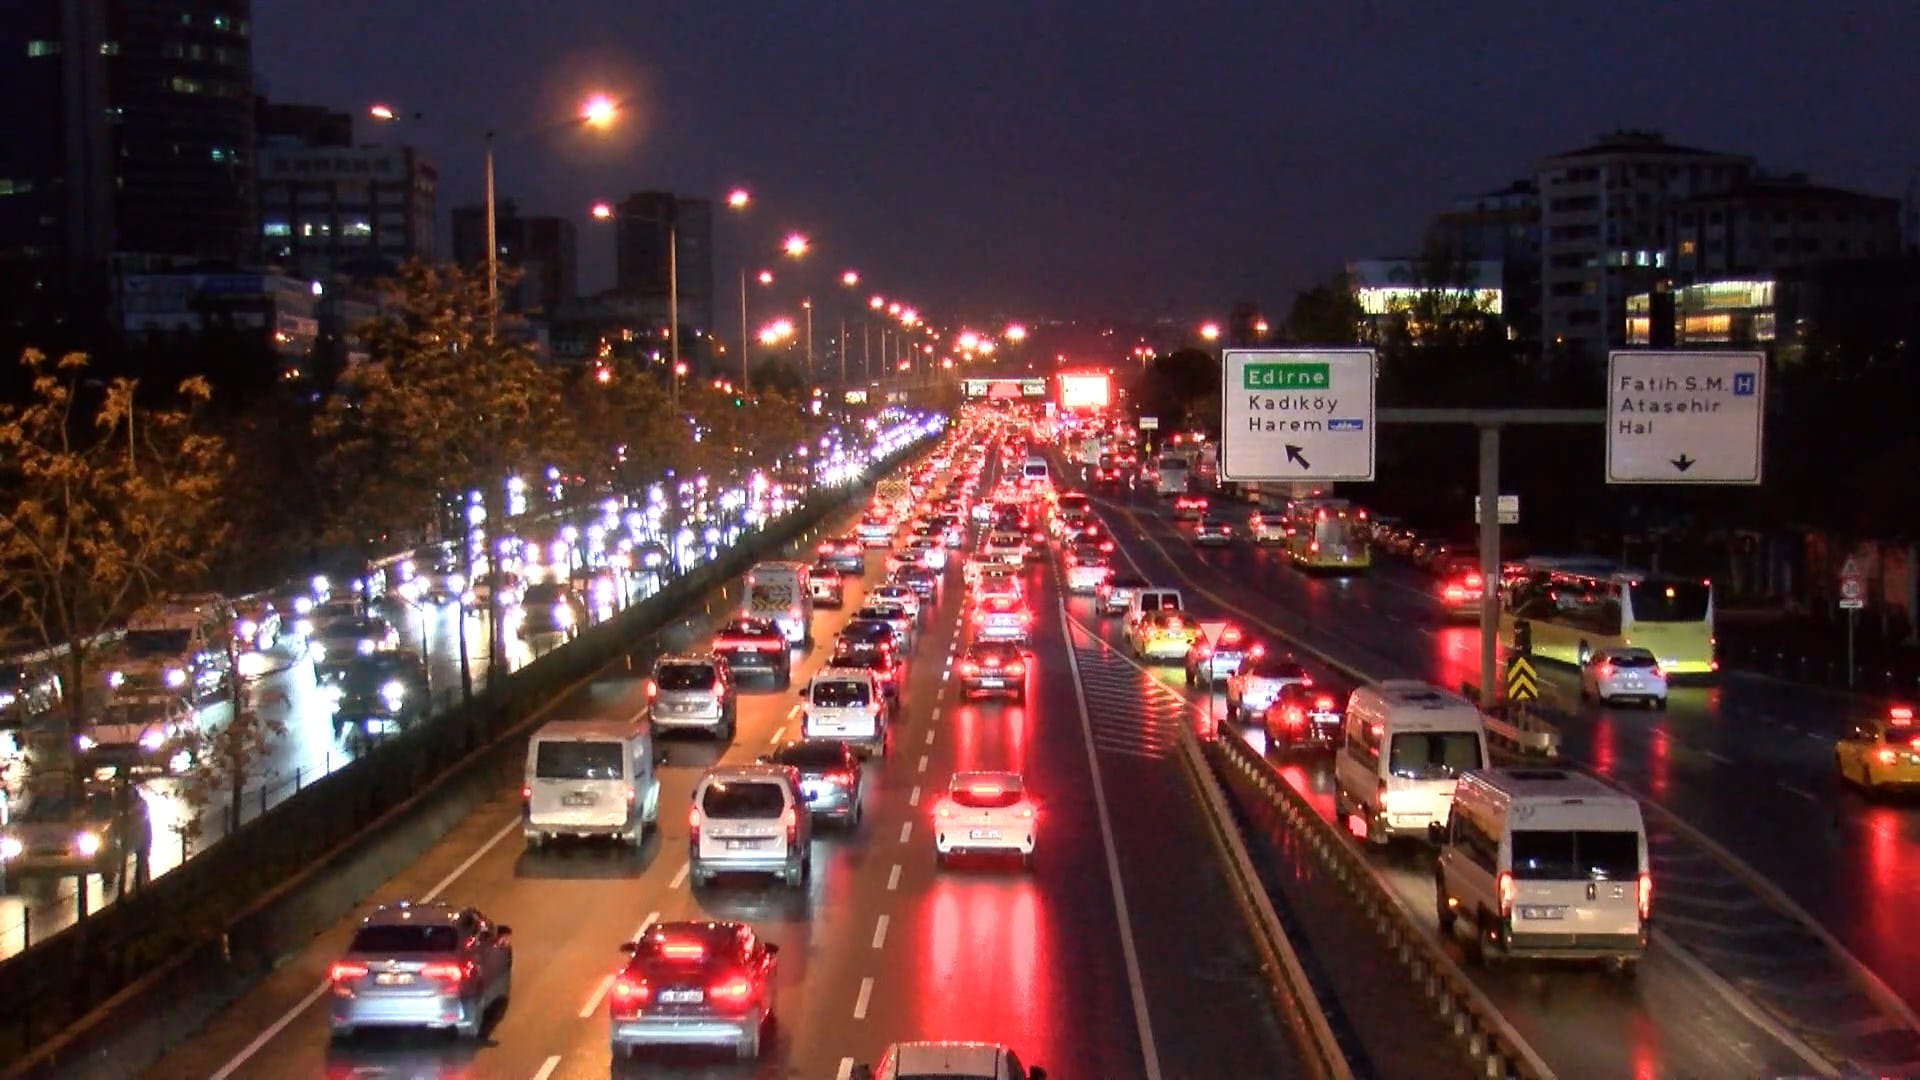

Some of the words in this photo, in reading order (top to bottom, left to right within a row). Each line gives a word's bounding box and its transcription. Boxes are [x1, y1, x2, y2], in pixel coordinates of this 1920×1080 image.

[1248, 369, 1325, 385] Edirne
[1620, 375, 1677, 391] Fatih
[1685, 375, 1729, 392] S.M.
[1249, 395, 1338, 414] Kadıköy
[1249, 417, 1322, 432] Harem
[1618, 420, 1652, 435] Hal
